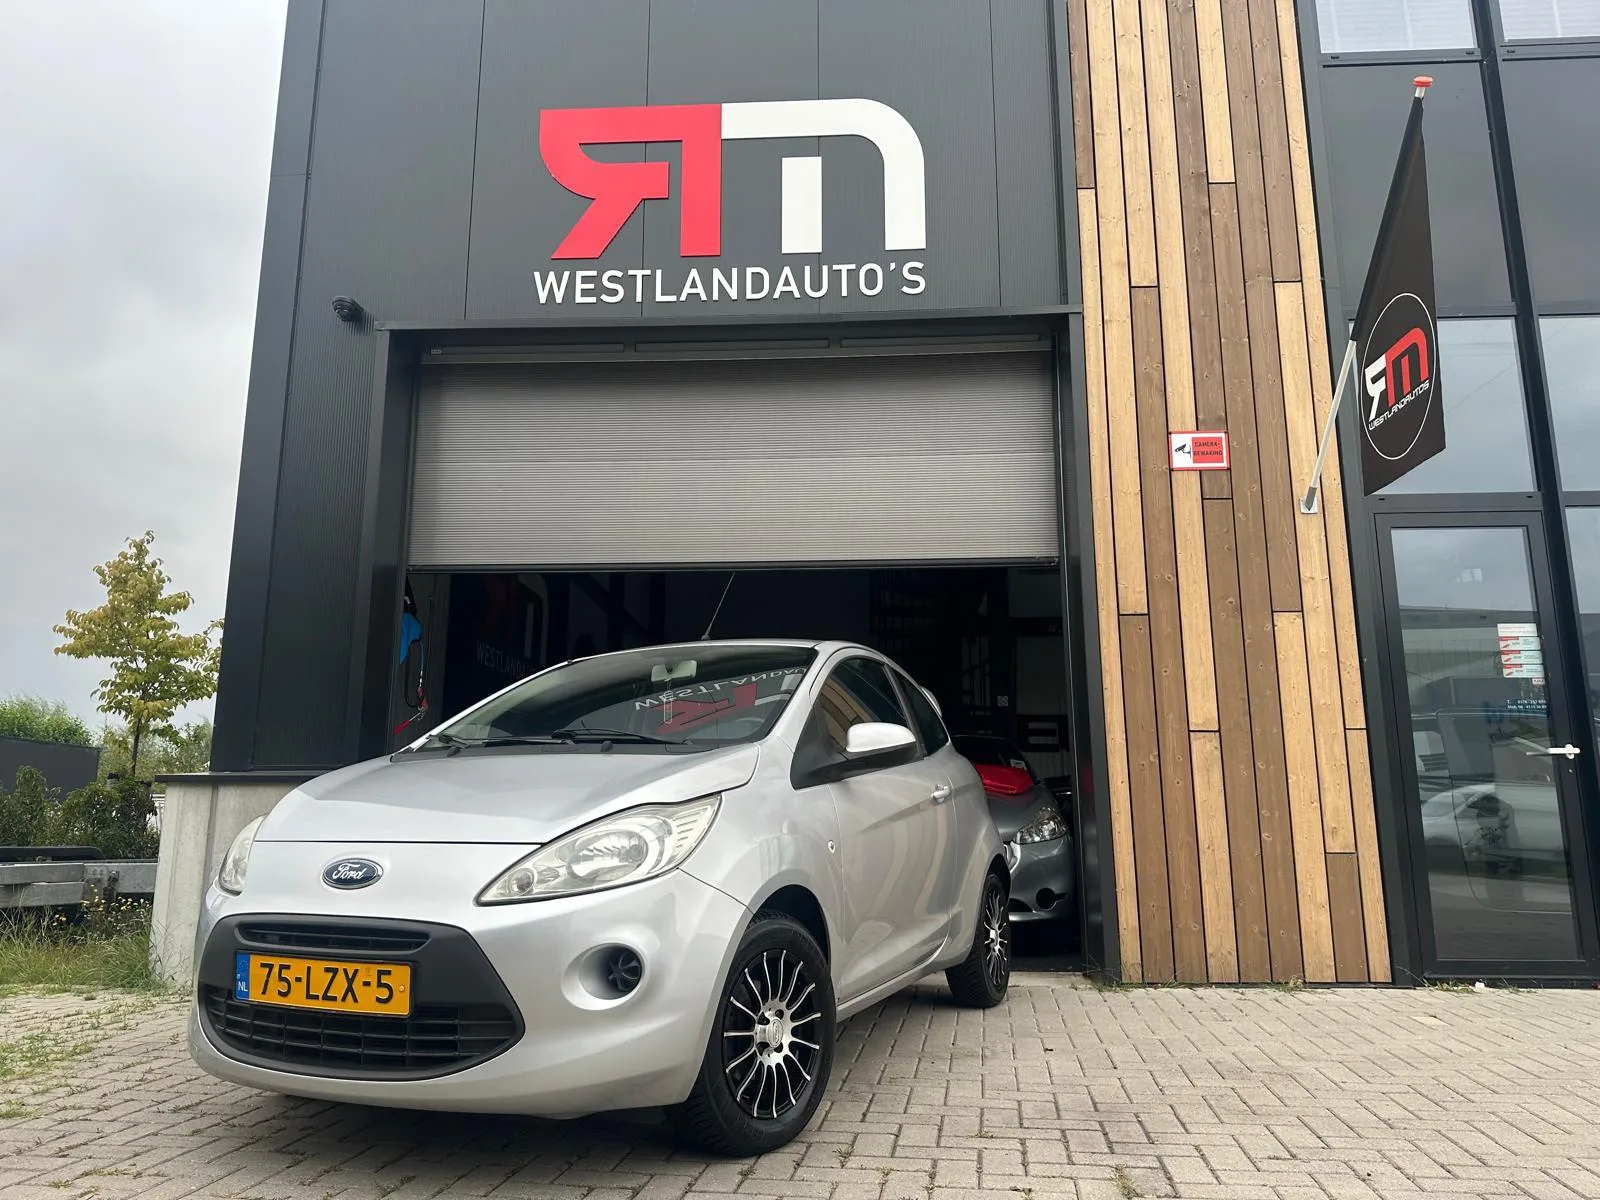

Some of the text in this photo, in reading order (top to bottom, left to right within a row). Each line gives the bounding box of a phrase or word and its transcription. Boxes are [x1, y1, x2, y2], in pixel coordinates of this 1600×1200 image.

[533, 262, 926, 303] WESTLANDAUTO'S
[1368, 378, 1430, 431] WESTLANDAUTOS
[332, 863, 367, 880] Ford
[238, 962, 394, 1004] NL 75-LZX-5
